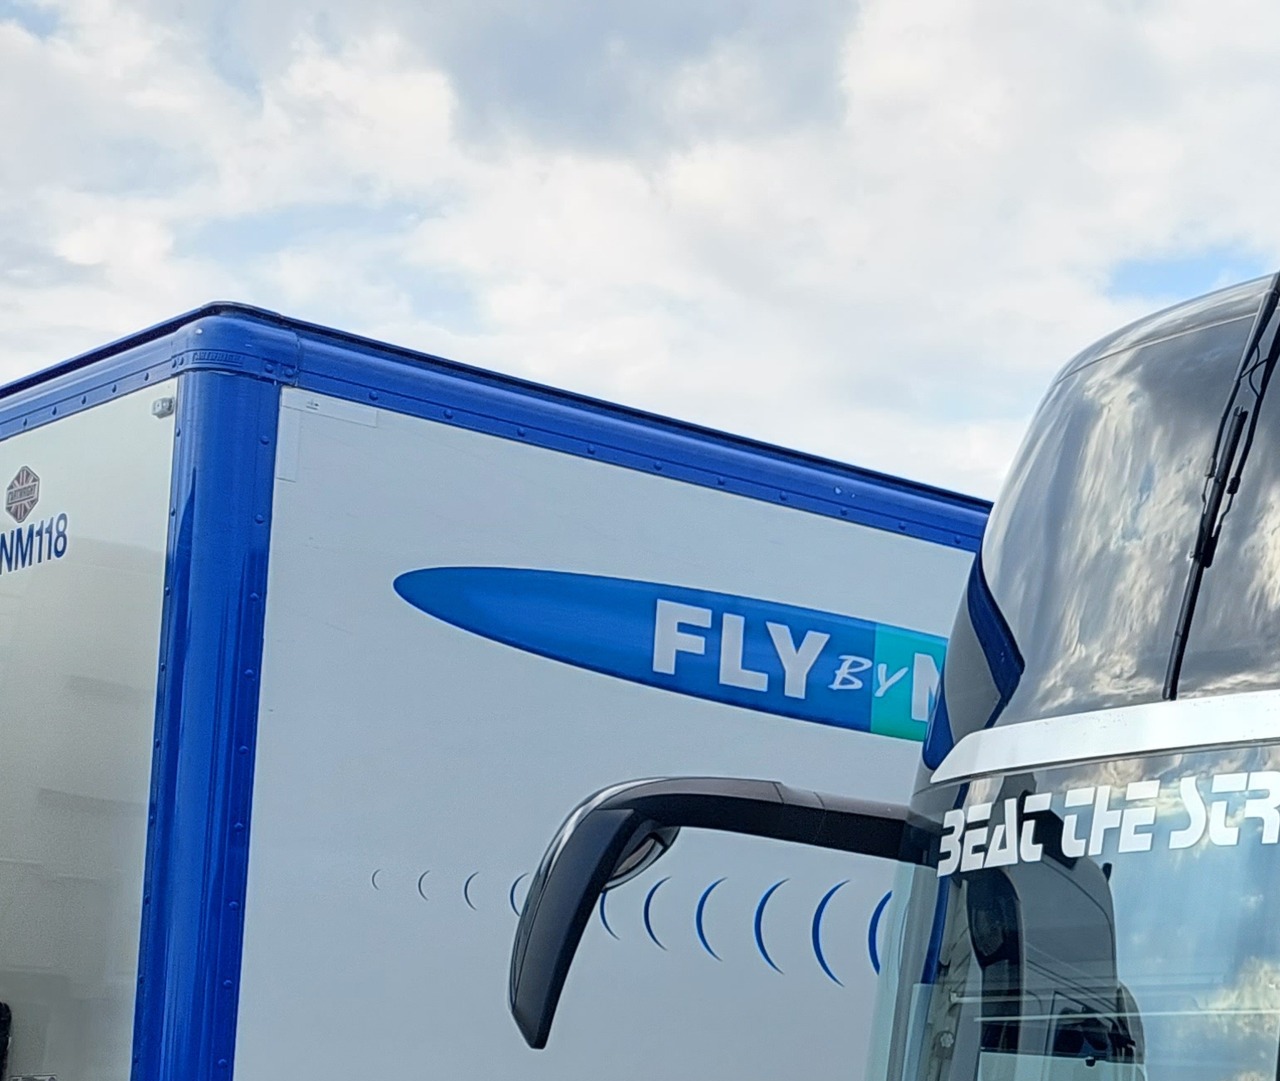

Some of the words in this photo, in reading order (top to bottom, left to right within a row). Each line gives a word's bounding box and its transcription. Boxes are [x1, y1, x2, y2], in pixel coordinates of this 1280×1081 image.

[653, 599, 830, 700] FLY
[937, 792, 1052, 877] BEAT
[1060, 779, 1160, 858] THE
